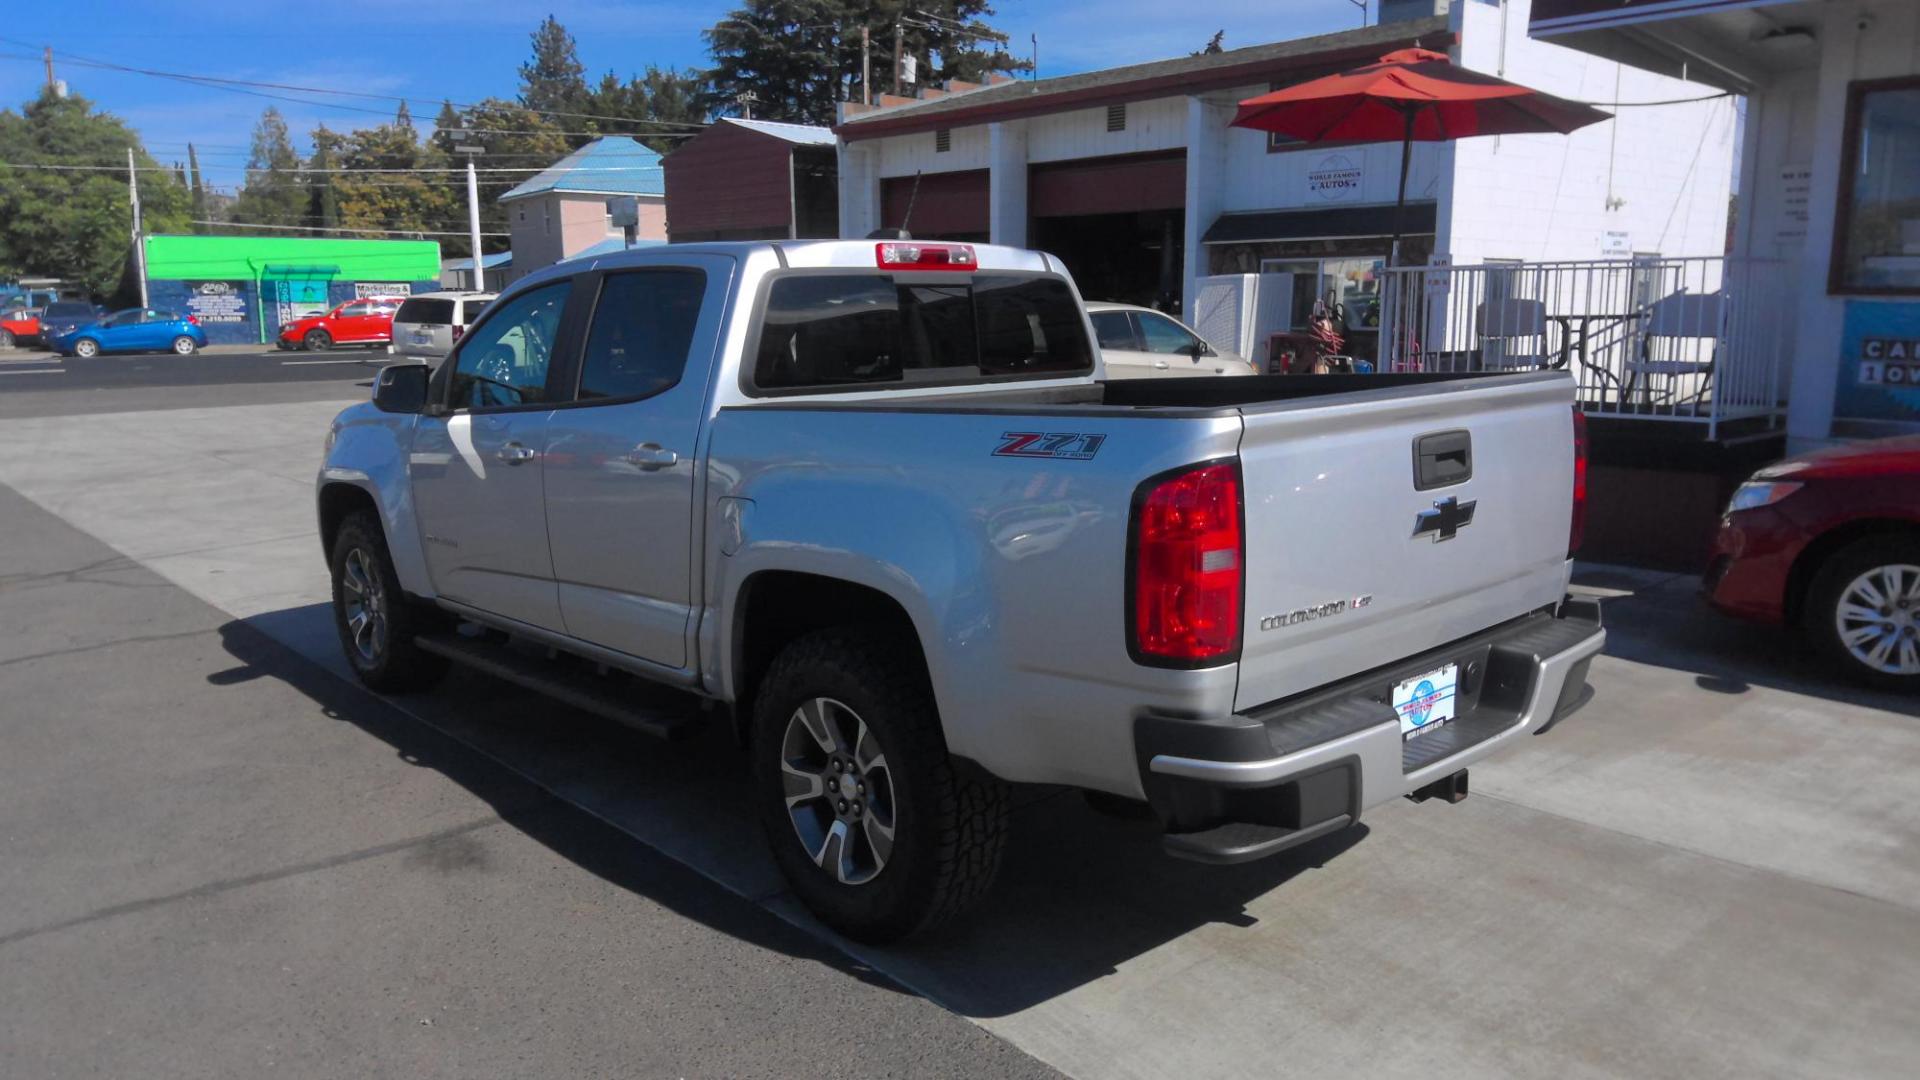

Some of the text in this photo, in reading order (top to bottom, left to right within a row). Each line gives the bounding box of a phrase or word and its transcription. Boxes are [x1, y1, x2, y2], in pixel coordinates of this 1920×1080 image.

[1319, 180, 1350, 190] AUTOS
[357, 284, 401, 292] Marketing
[991, 431, 1108, 461] Z71
